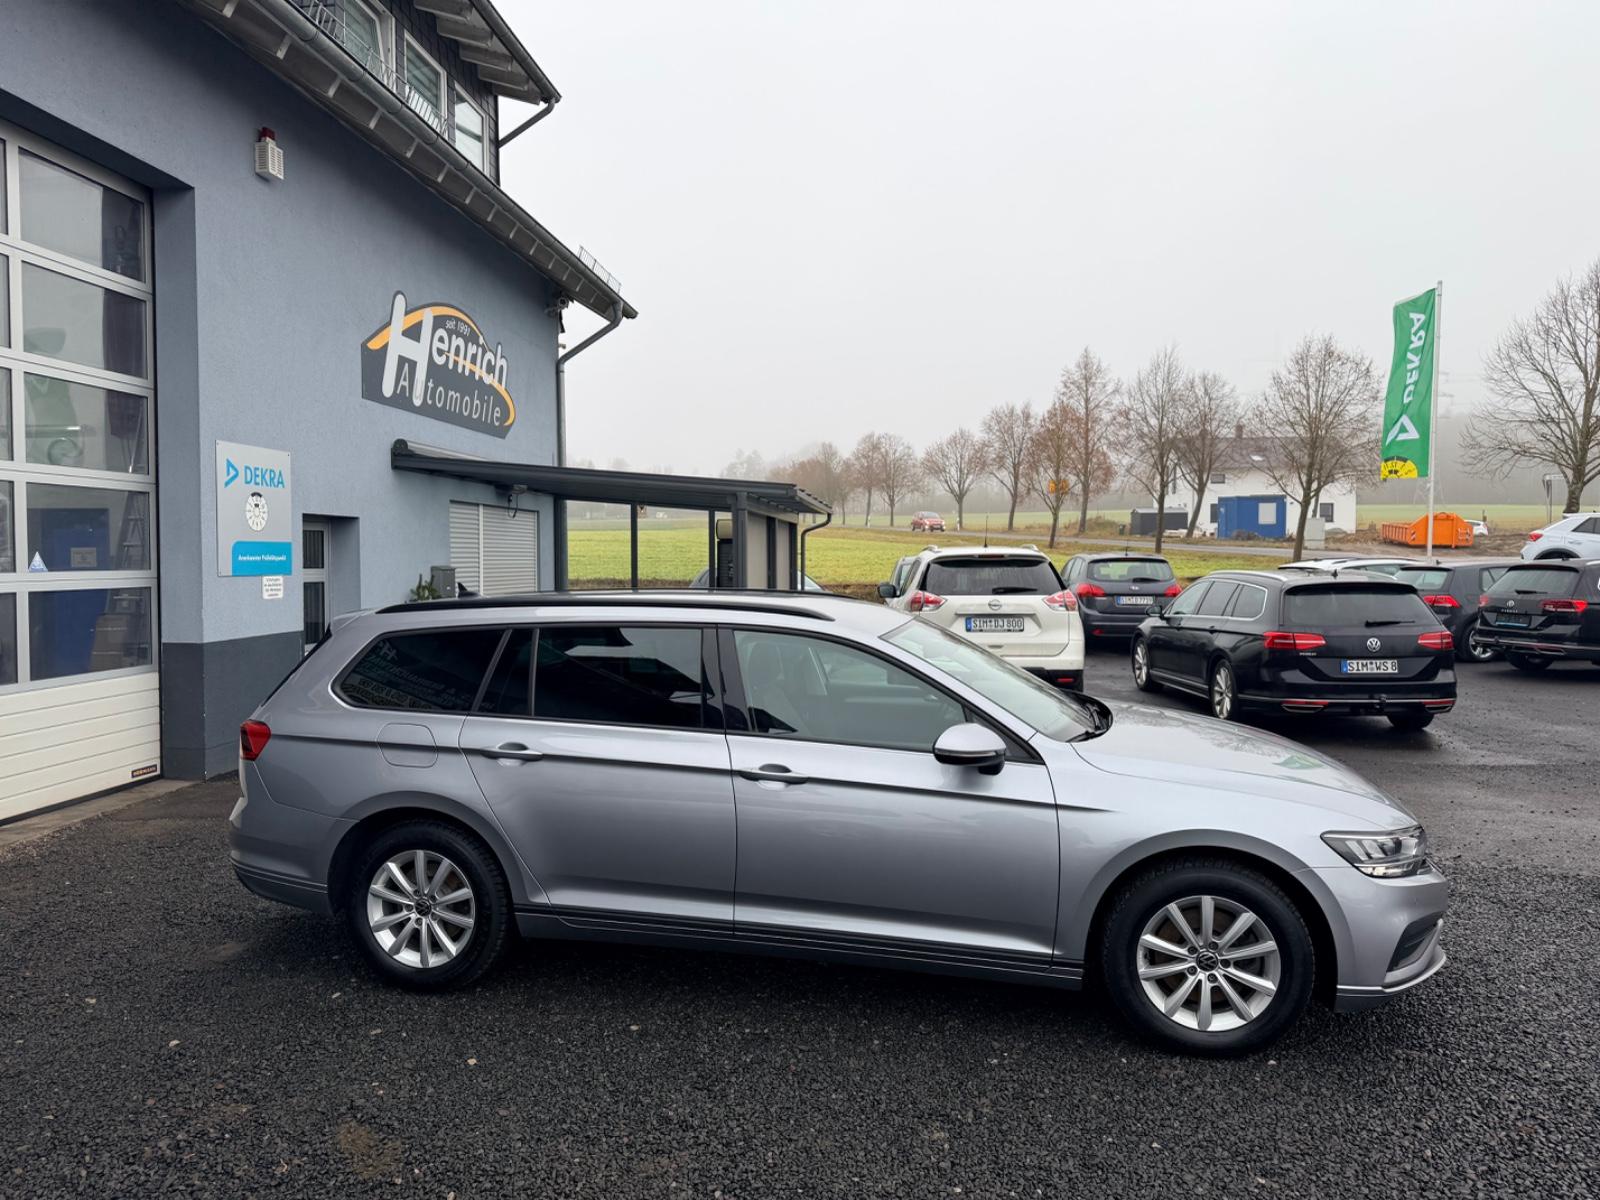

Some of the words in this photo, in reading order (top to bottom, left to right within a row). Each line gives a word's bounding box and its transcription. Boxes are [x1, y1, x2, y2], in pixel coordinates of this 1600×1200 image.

[382, 294, 508, 407] Henrich
[244, 465, 285, 488] DEKRA
[1348, 661, 1369, 672] SIM
[1375, 661, 1389, 672] WS
[1391, 661, 1397, 672] 8
